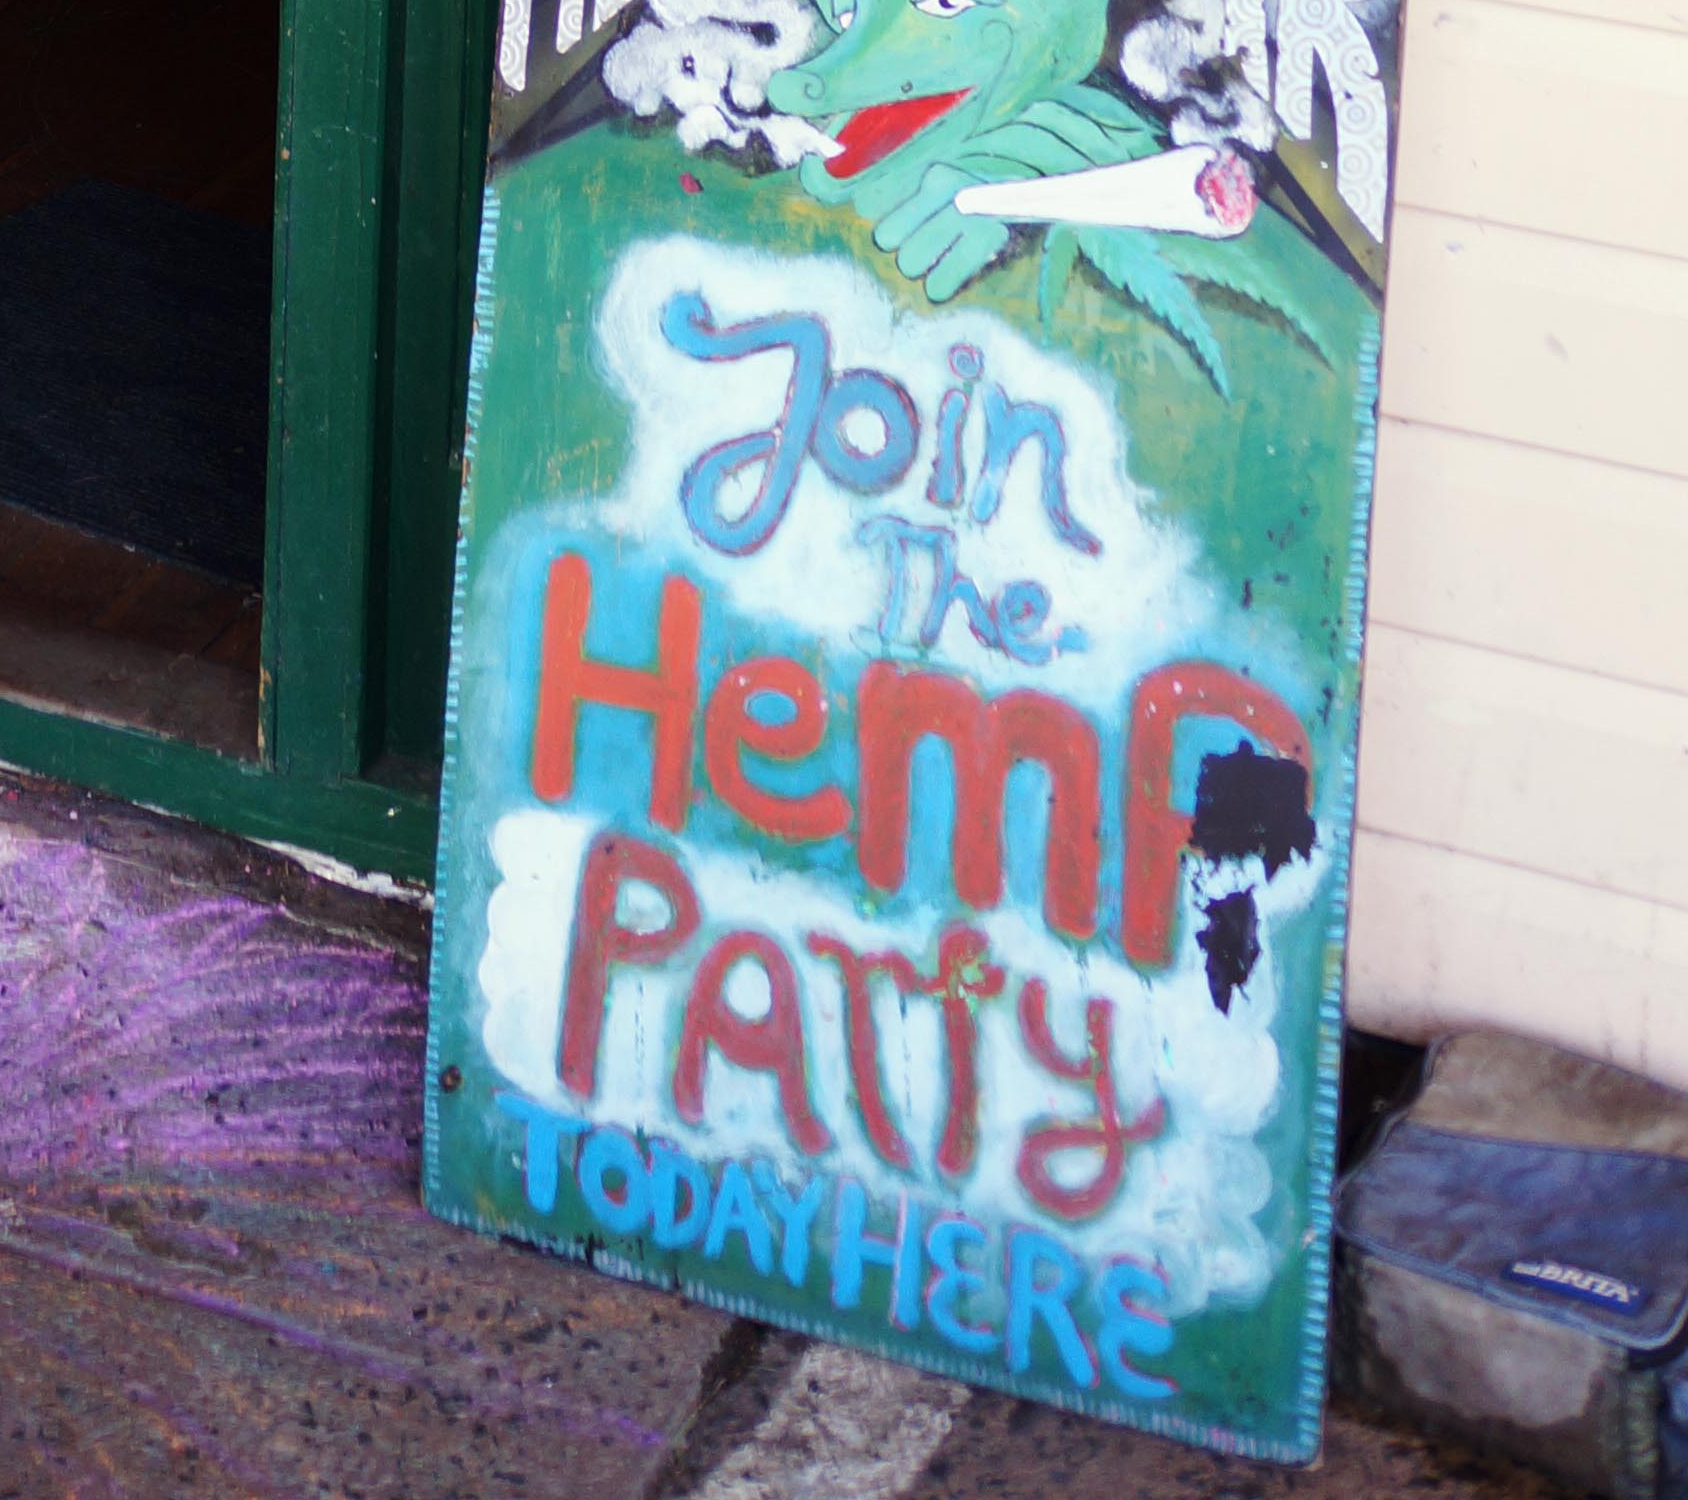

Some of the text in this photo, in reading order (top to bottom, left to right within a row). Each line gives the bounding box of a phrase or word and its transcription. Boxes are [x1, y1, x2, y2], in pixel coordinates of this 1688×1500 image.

[660, 288, 1102, 558] Join
[857, 512, 1089, 666] The
[495, 1090, 1181, 1400] TODAY HERE
